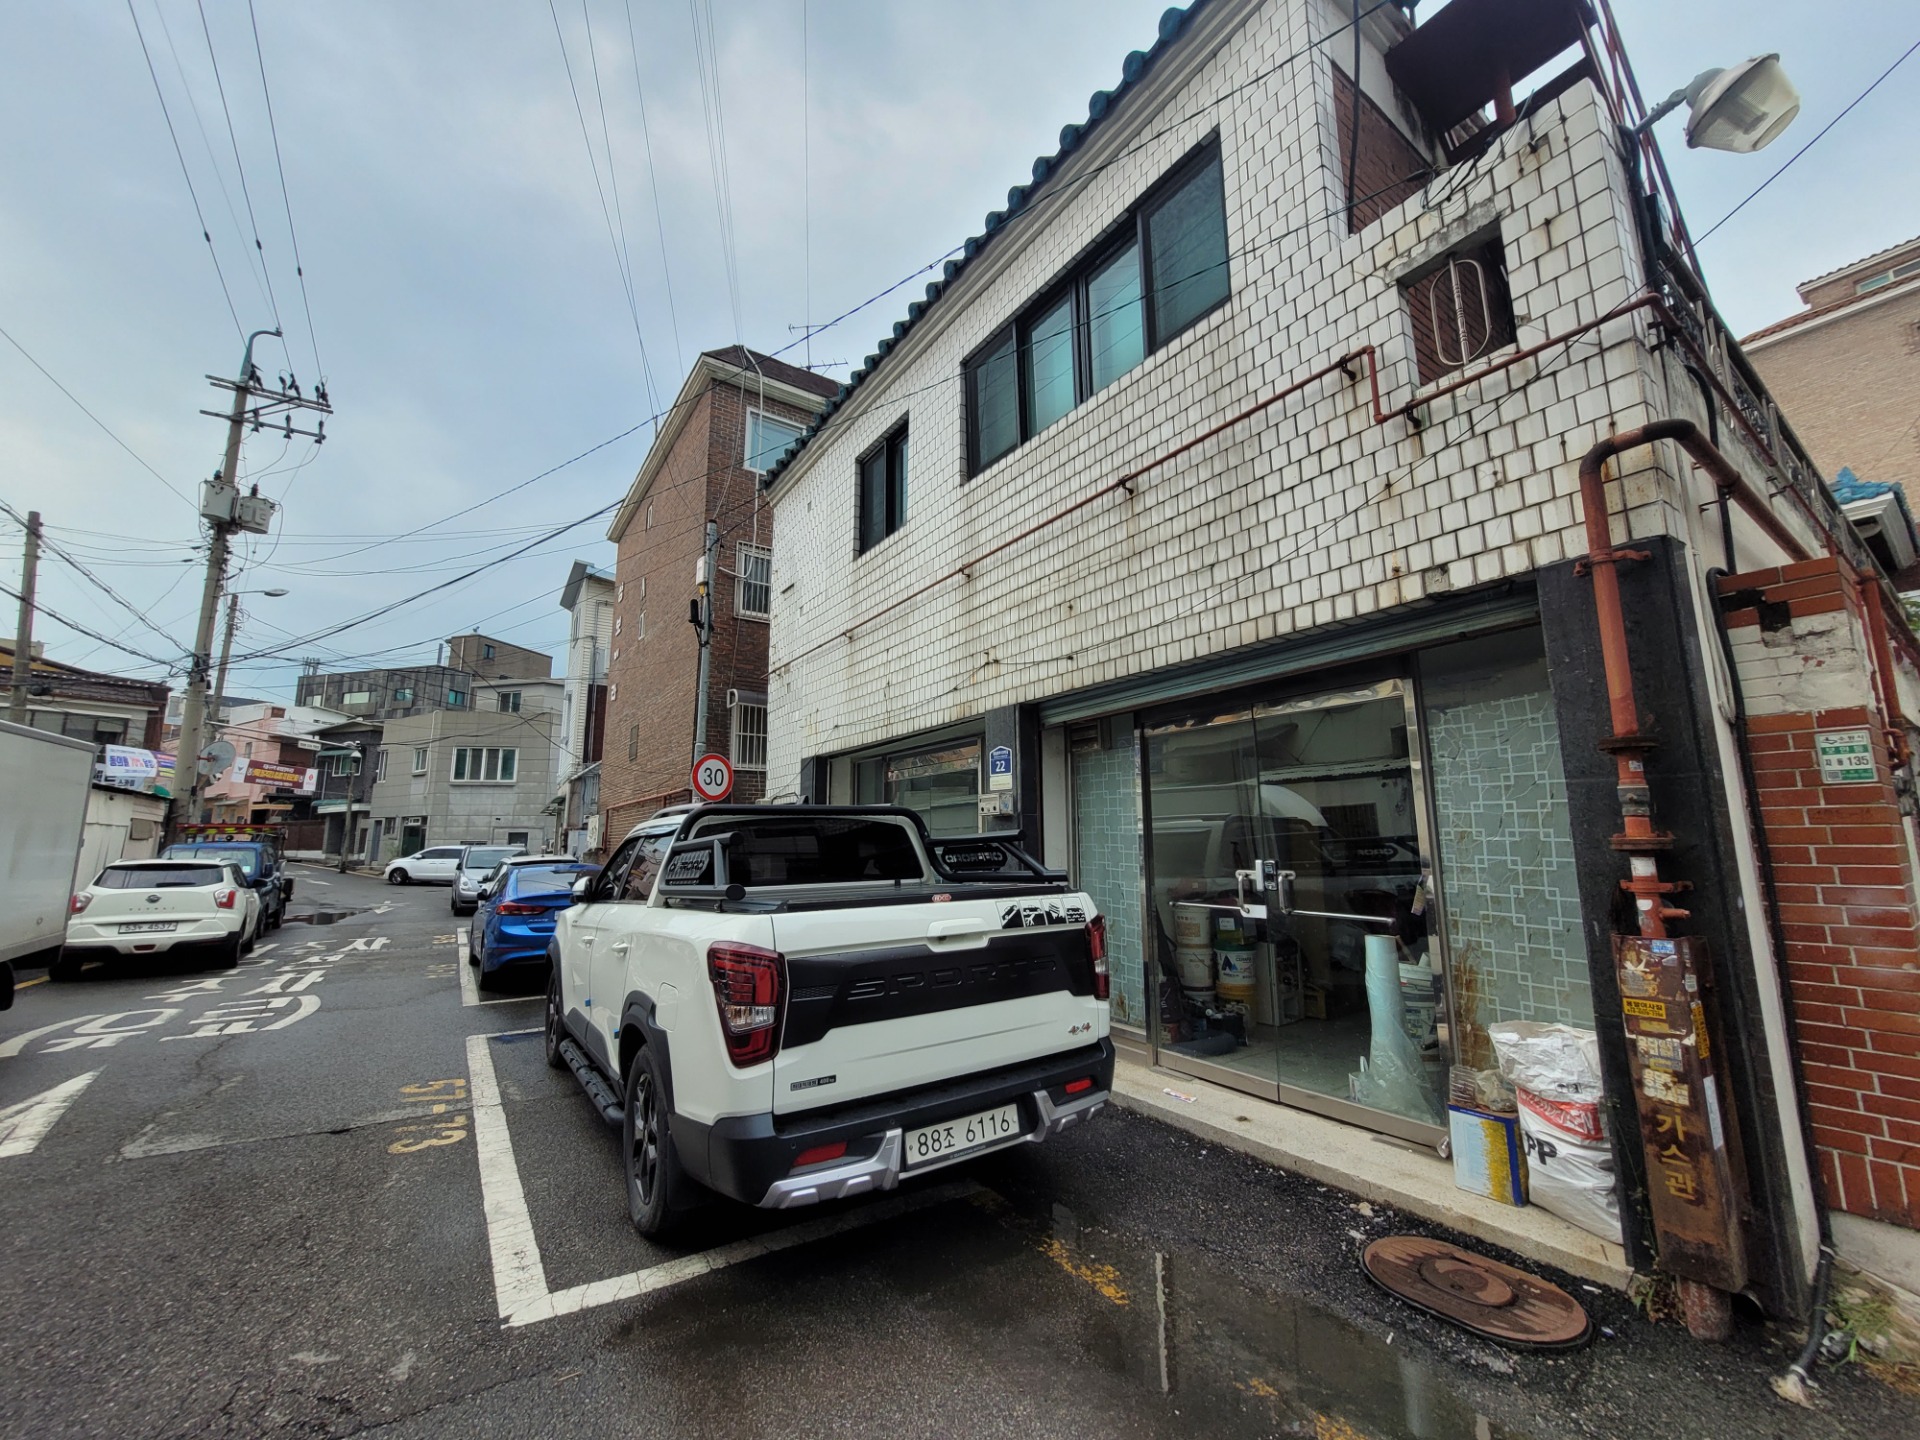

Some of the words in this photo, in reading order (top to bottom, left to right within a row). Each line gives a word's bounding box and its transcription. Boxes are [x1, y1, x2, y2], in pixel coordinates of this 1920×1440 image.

[703, 767, 724, 787] 30
[995, 760, 1006, 772] 22
[1847, 756, 1869, 766] 135
[847, 954, 1056, 1000] SPORTS
[917, 1126, 956, 1157] 88조
[965, 1110, 1010, 1143] 6116
[1655, 1114, 1697, 1201] 가스관
